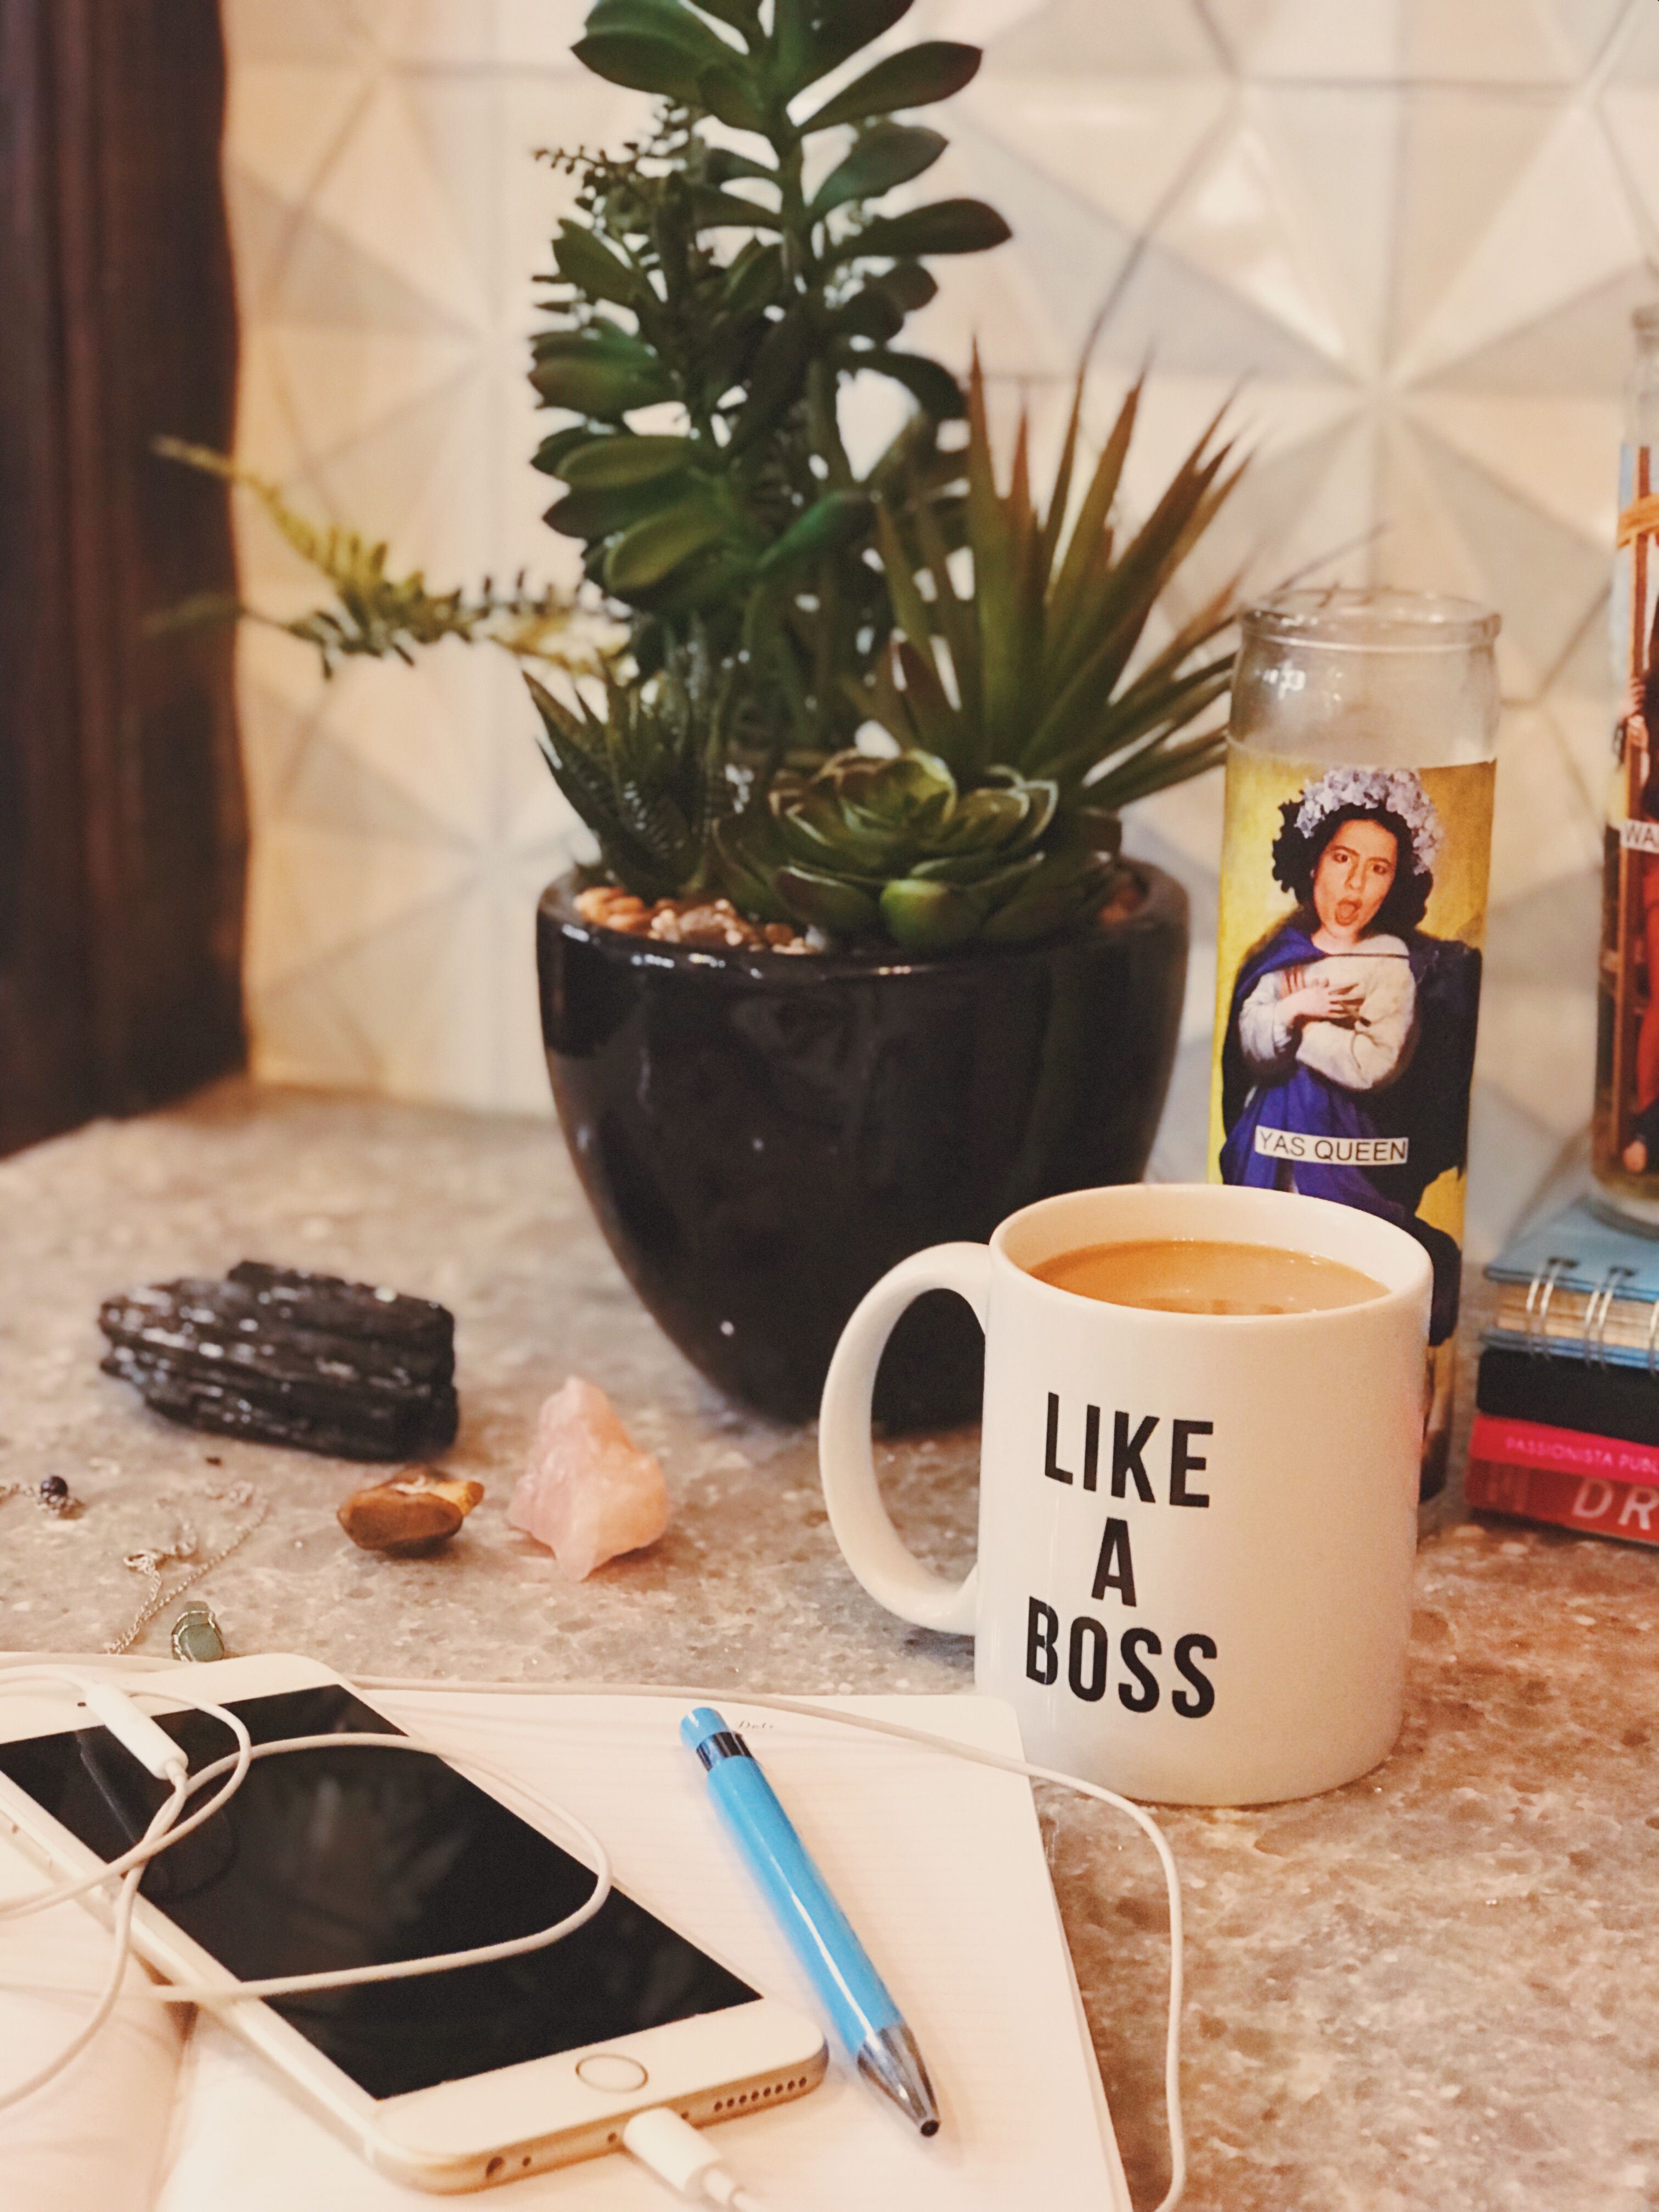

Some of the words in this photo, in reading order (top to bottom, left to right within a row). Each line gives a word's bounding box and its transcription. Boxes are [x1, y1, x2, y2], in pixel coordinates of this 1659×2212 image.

[1259, 1130, 1305, 1156] YAS
[1315, 1140, 1406, 1161] QUEEN
[1045, 1391, 1214, 1508] LIKE
[1091, 1516, 1137, 1607] A
[1026, 1596, 1217, 1719] BOSS
